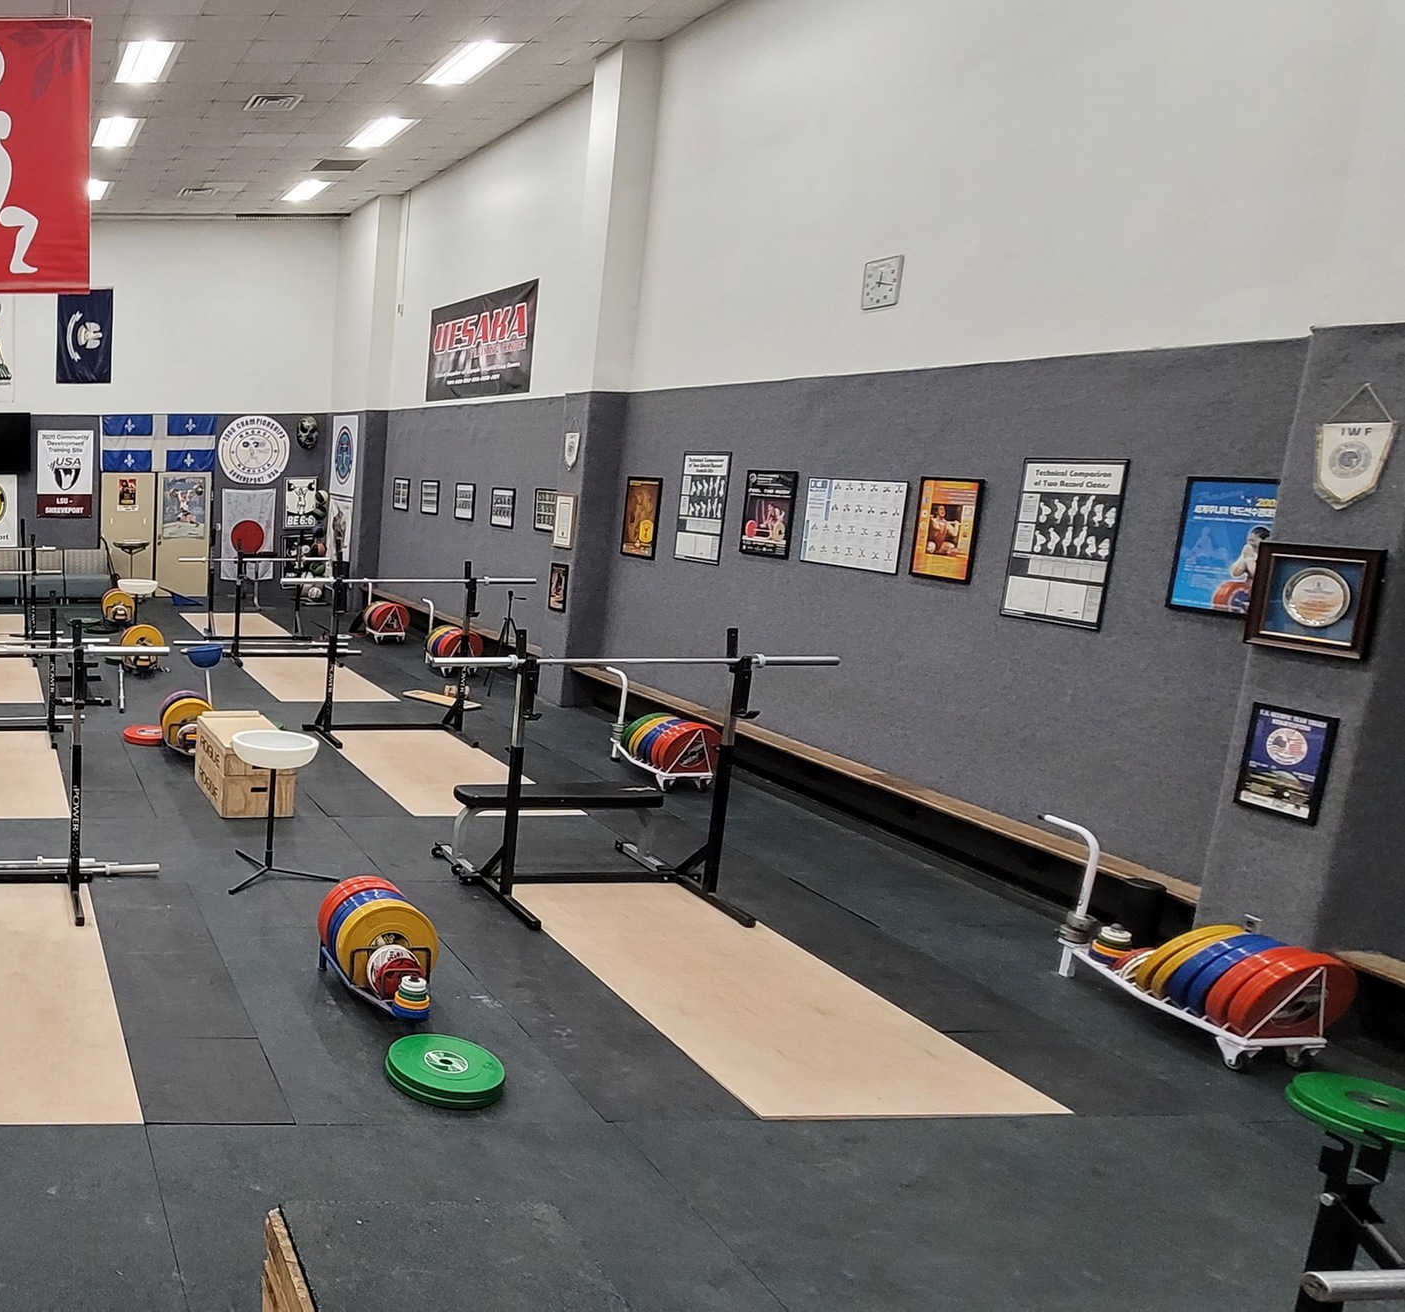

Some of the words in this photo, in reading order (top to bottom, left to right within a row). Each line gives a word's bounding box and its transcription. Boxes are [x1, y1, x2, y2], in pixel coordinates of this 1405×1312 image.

[433, 302, 527, 355] UESAKA
[236, 418, 286, 439] CHAMPIONSHIPS
[55, 457, 81, 466] USA
[1035, 469, 1068, 477] Technical
[1069, 470, 1112, 478] Comparison
[1059, 480, 1084, 488] Record
[56, 497, 68, 505] LSU
[287, 515, 299, 525] BE
[199, 734, 221, 769] ROGUE
[198, 766, 219, 801] ROGUE
